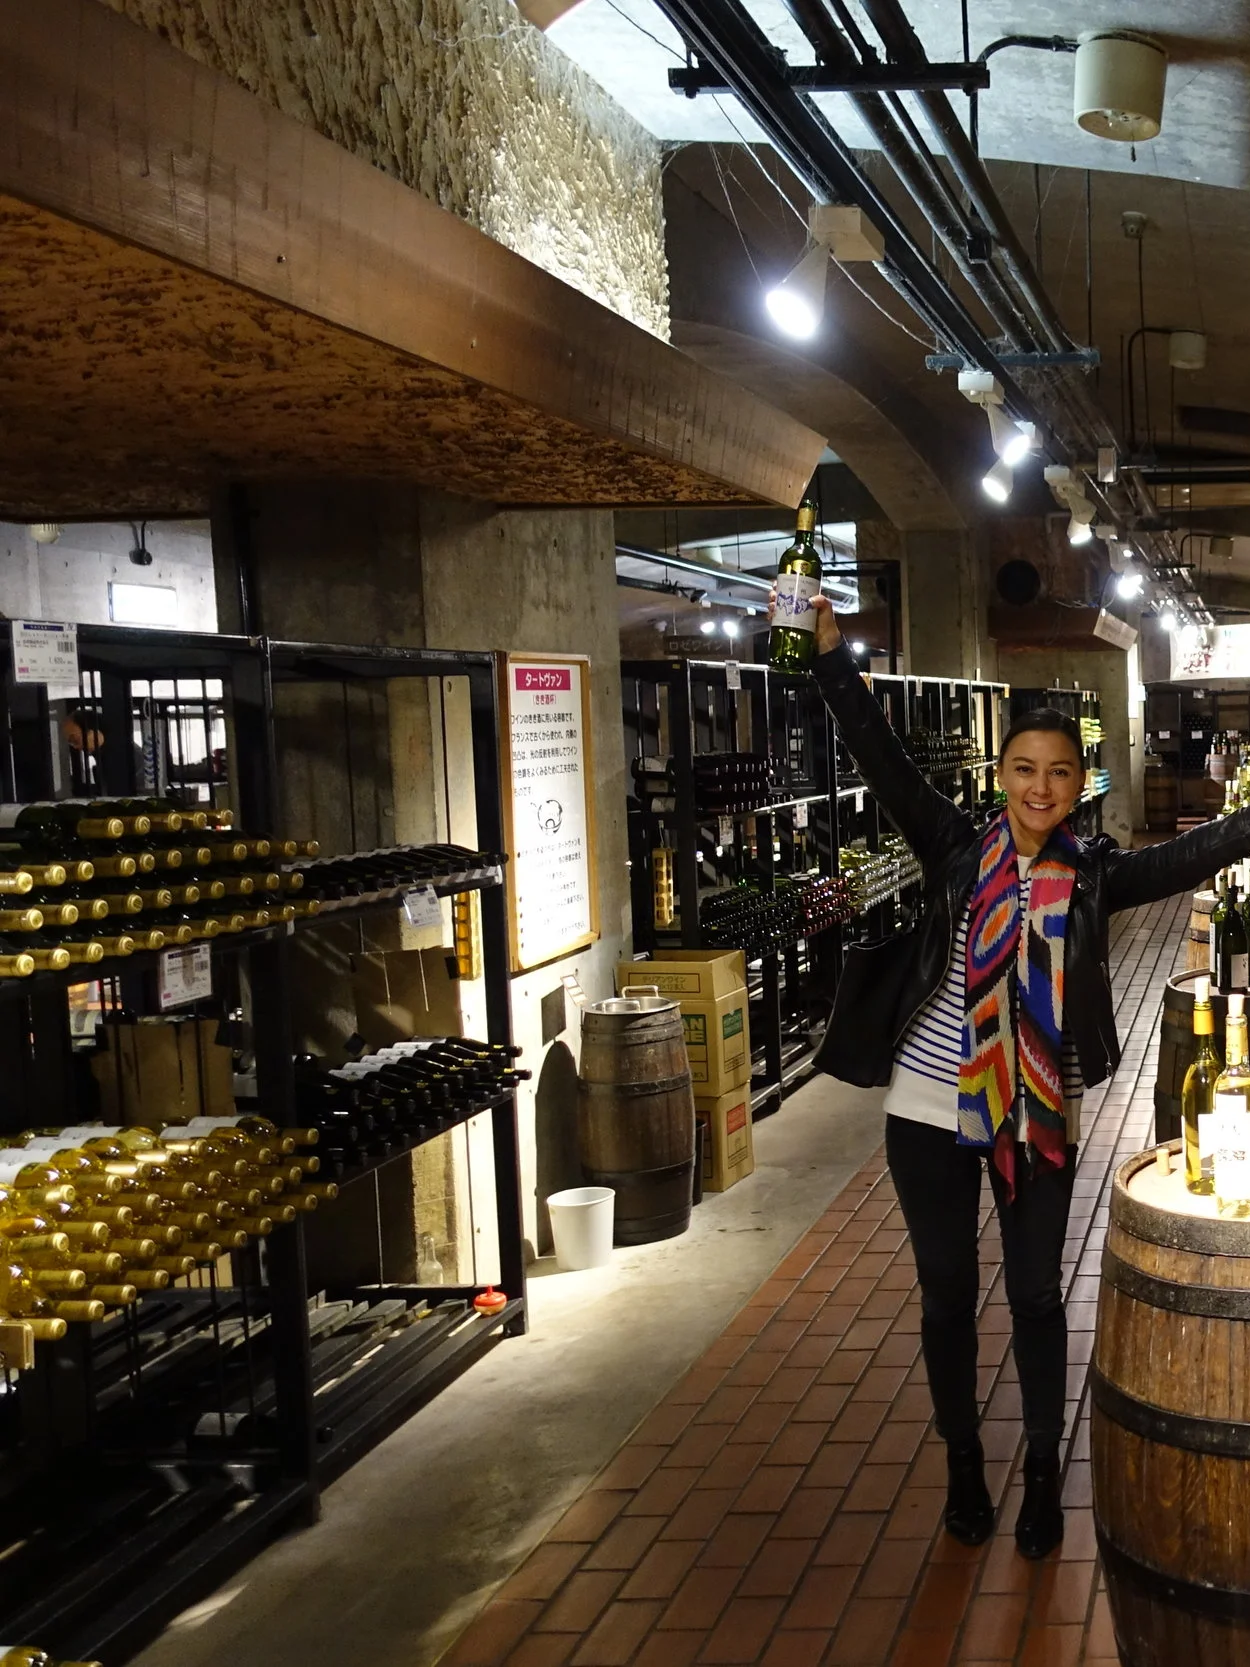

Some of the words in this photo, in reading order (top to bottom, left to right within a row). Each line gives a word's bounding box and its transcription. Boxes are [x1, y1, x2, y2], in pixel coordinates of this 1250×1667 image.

[525, 671, 562, 688] タートヴァン
[681, 1018, 704, 1030] AN
